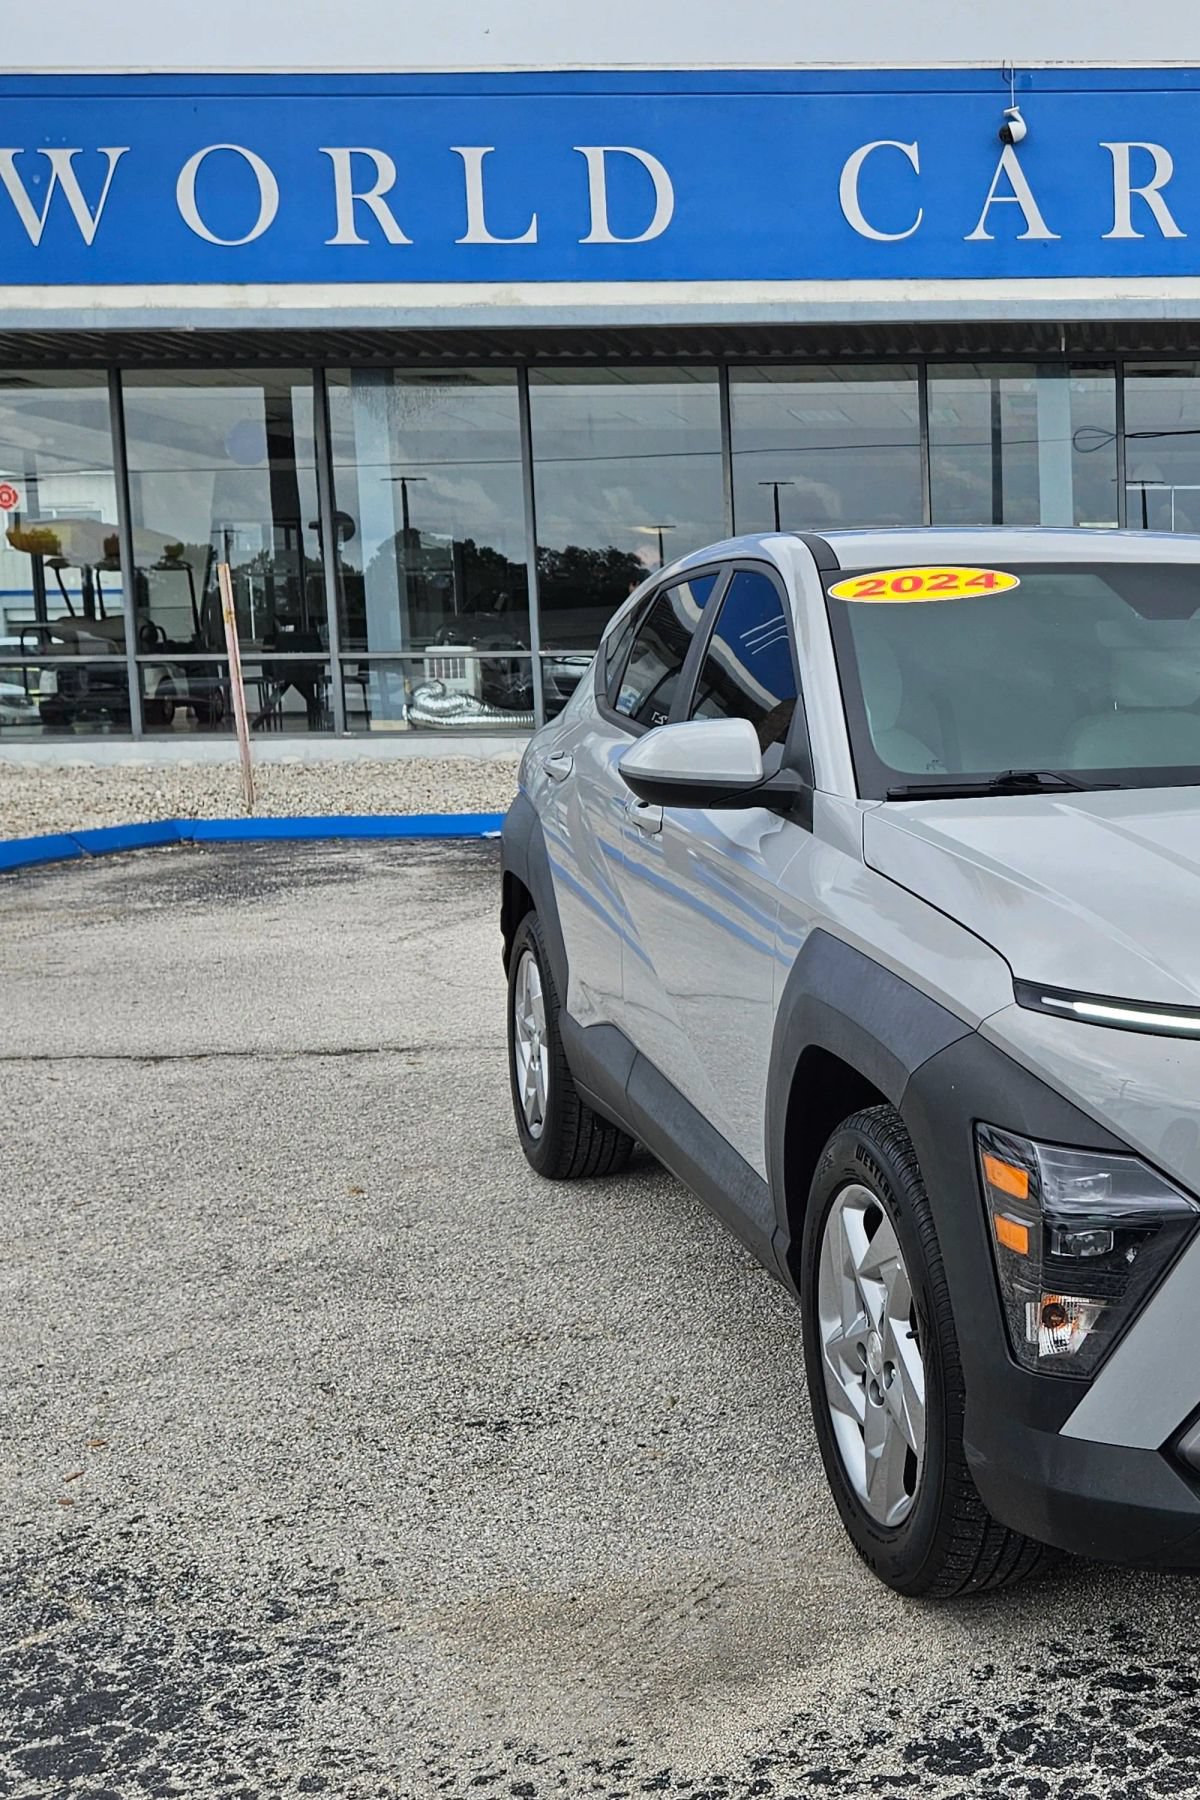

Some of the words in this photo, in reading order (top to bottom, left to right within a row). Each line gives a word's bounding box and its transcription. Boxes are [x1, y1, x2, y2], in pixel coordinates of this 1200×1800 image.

[0, 143, 675, 246] WORLD
[839, 140, 1188, 241] CAR
[852, 572, 999, 598] 2024
[855, 1143, 902, 1220] WESTLAKE
